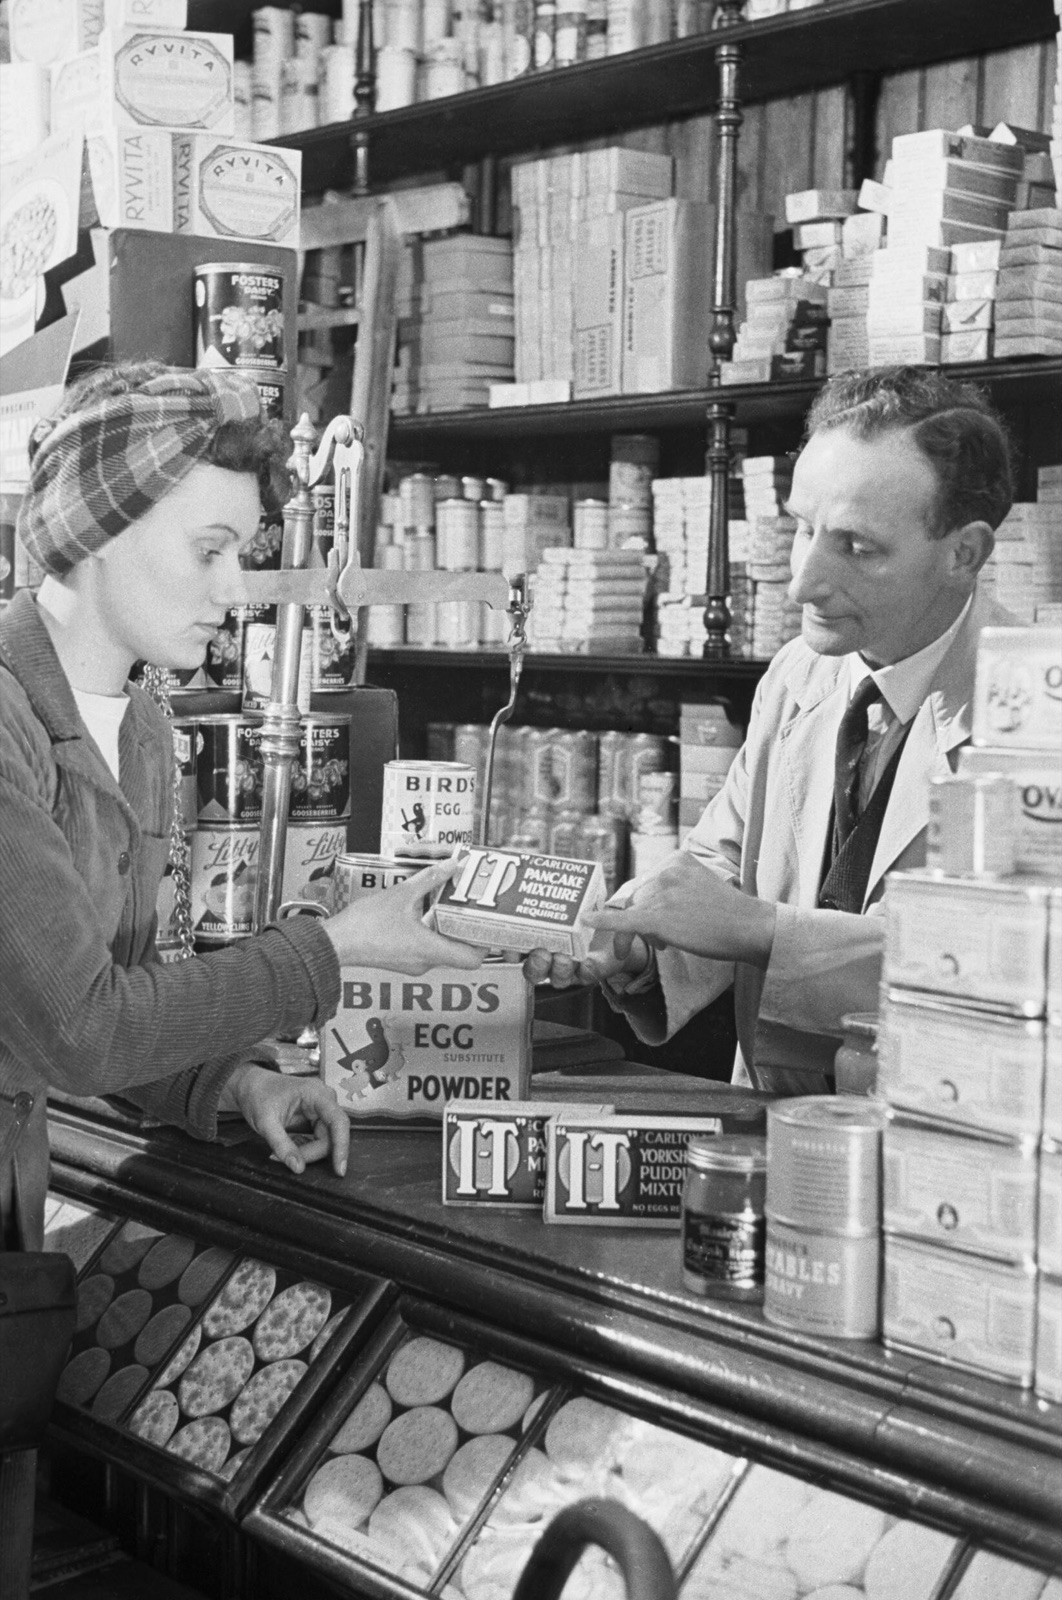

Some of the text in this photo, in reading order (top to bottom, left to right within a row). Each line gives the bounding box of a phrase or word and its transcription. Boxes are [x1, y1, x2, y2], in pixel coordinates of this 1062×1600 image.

[129, 43, 214, 72] RYVITA
[123, 135, 145, 221] RYVITA
[213, 156, 285, 187] RYVITA
[177, 143, 192, 230] RYVITA
[231, 274, 279, 290] FOSTERS
[406, 775, 475, 793] BIRD'S
[435, 802, 461, 816] EGG
[533, 857, 589, 874] CARLTONA
[523, 866, 586, 889] PANCAKE
[518, 880, 581, 902] MIXTURE
[515, 904, 569, 921] REQUIRED
[522, 897, 567, 912] NO EGGS
[343, 981, 500, 1013] BIRD'S
[414, 1023, 474, 1050] EGG
[443, 1053, 505, 1063] SUBSTITUTE
[407, 1074, 511, 1101] POWDER
[632, 1203, 646, 1212] NO
